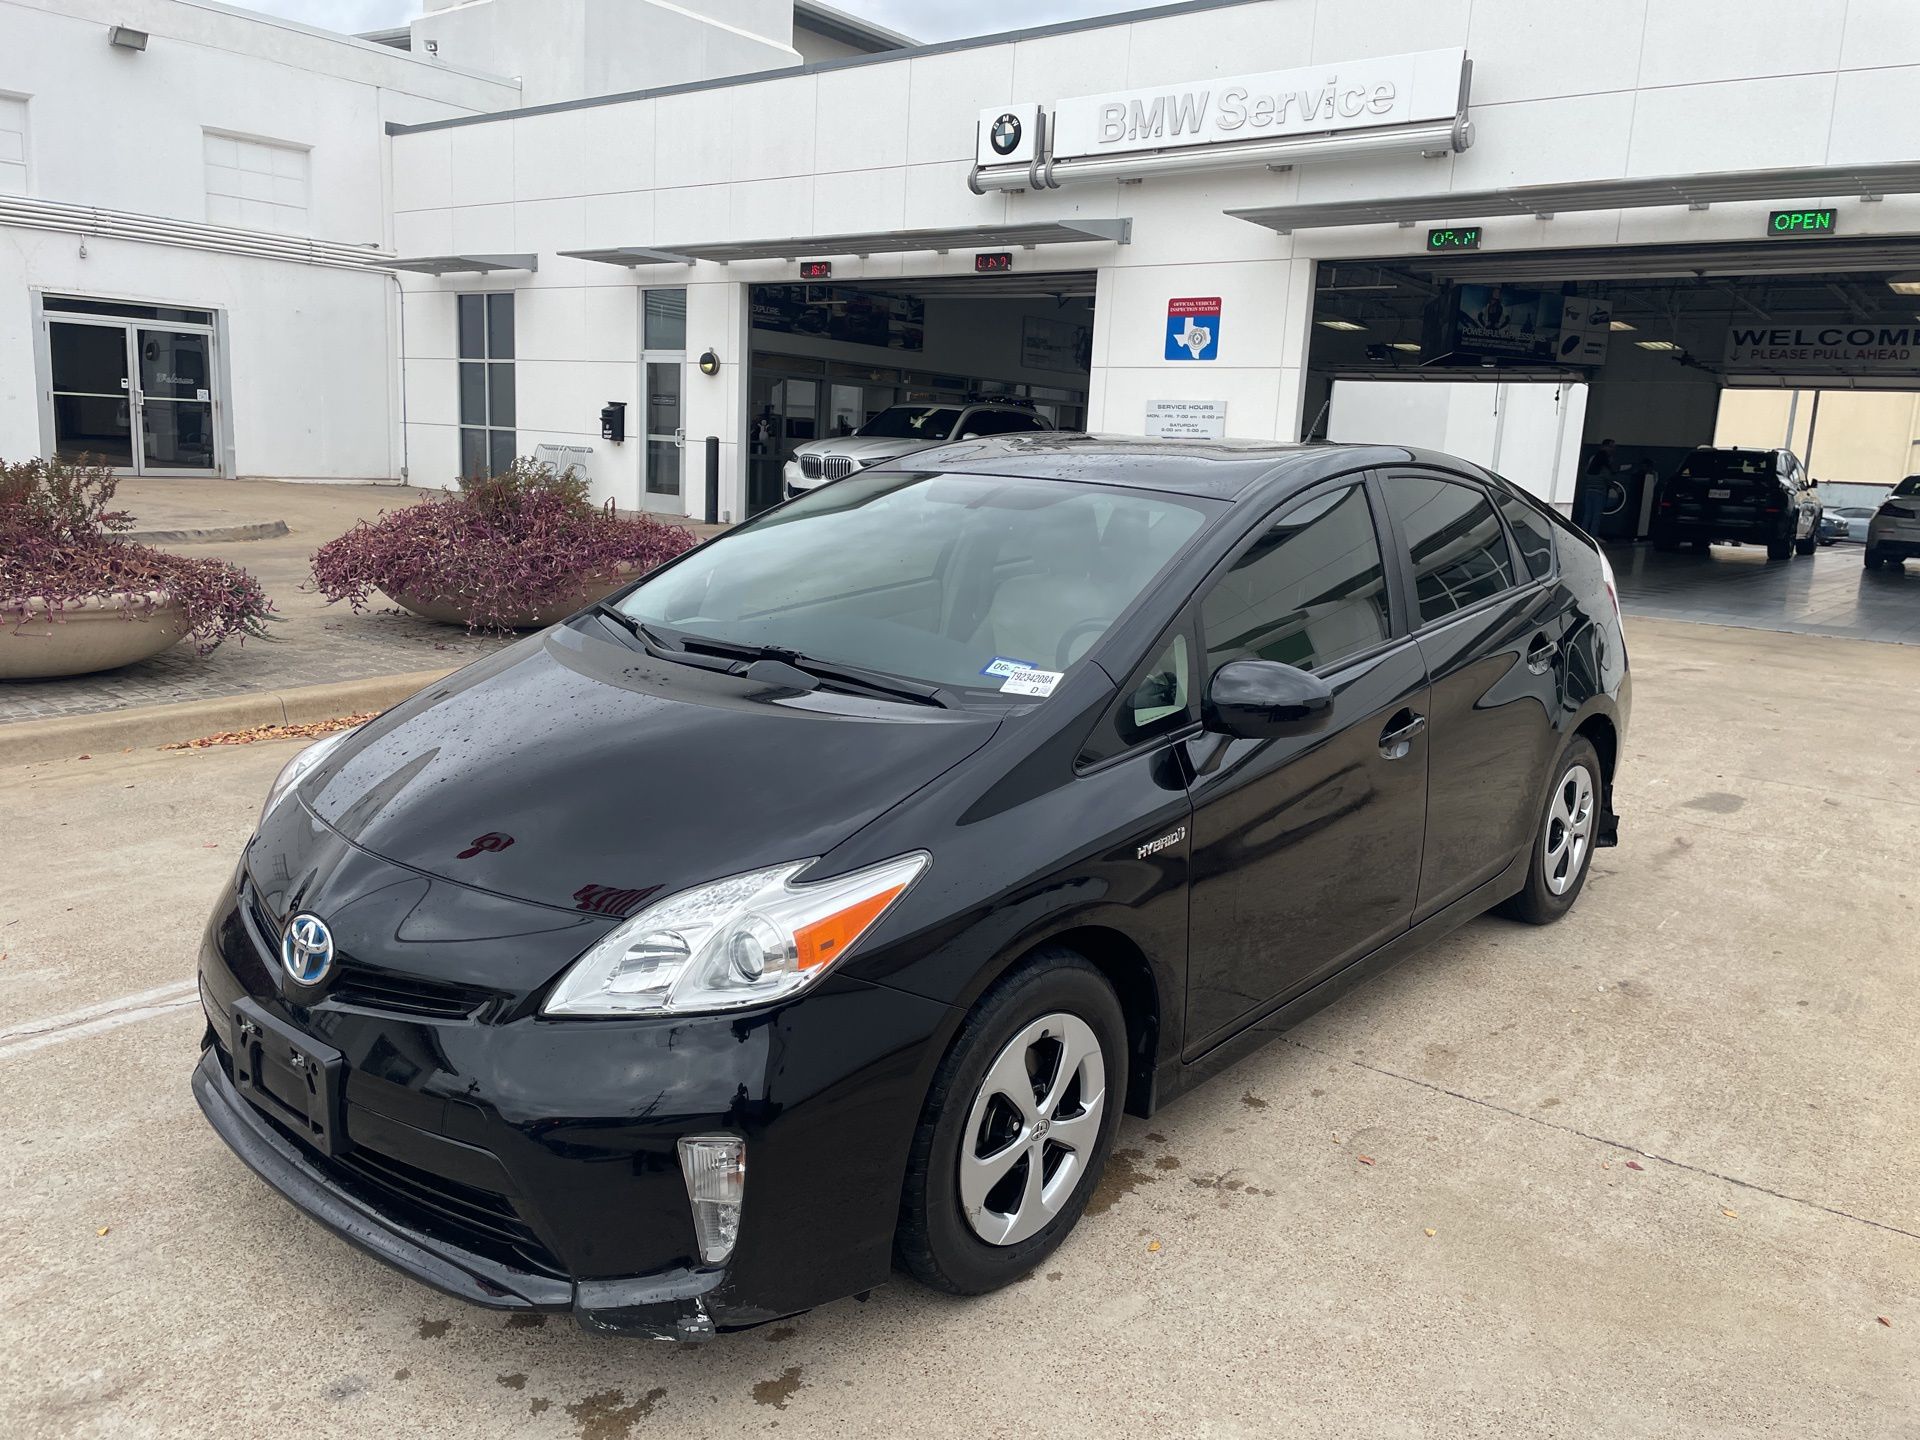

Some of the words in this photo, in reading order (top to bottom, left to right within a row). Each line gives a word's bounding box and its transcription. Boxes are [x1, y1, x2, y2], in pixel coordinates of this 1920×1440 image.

[1098, 90, 1210, 144] BMW
[1214, 74, 1396, 131] Service
[993, 115, 1019, 130] BMW
[1774, 212, 1831, 230] OPEN
[1750, 348, 1809, 360] PLEASE
[1812, 348, 1855, 360] PULL
[1855, 348, 1911, 360] AHEAD
[1010, 671, 1054, 684] T9234208A
[1030, 686, 1039, 694] D
[1137, 831, 1180, 860] HYBRID
